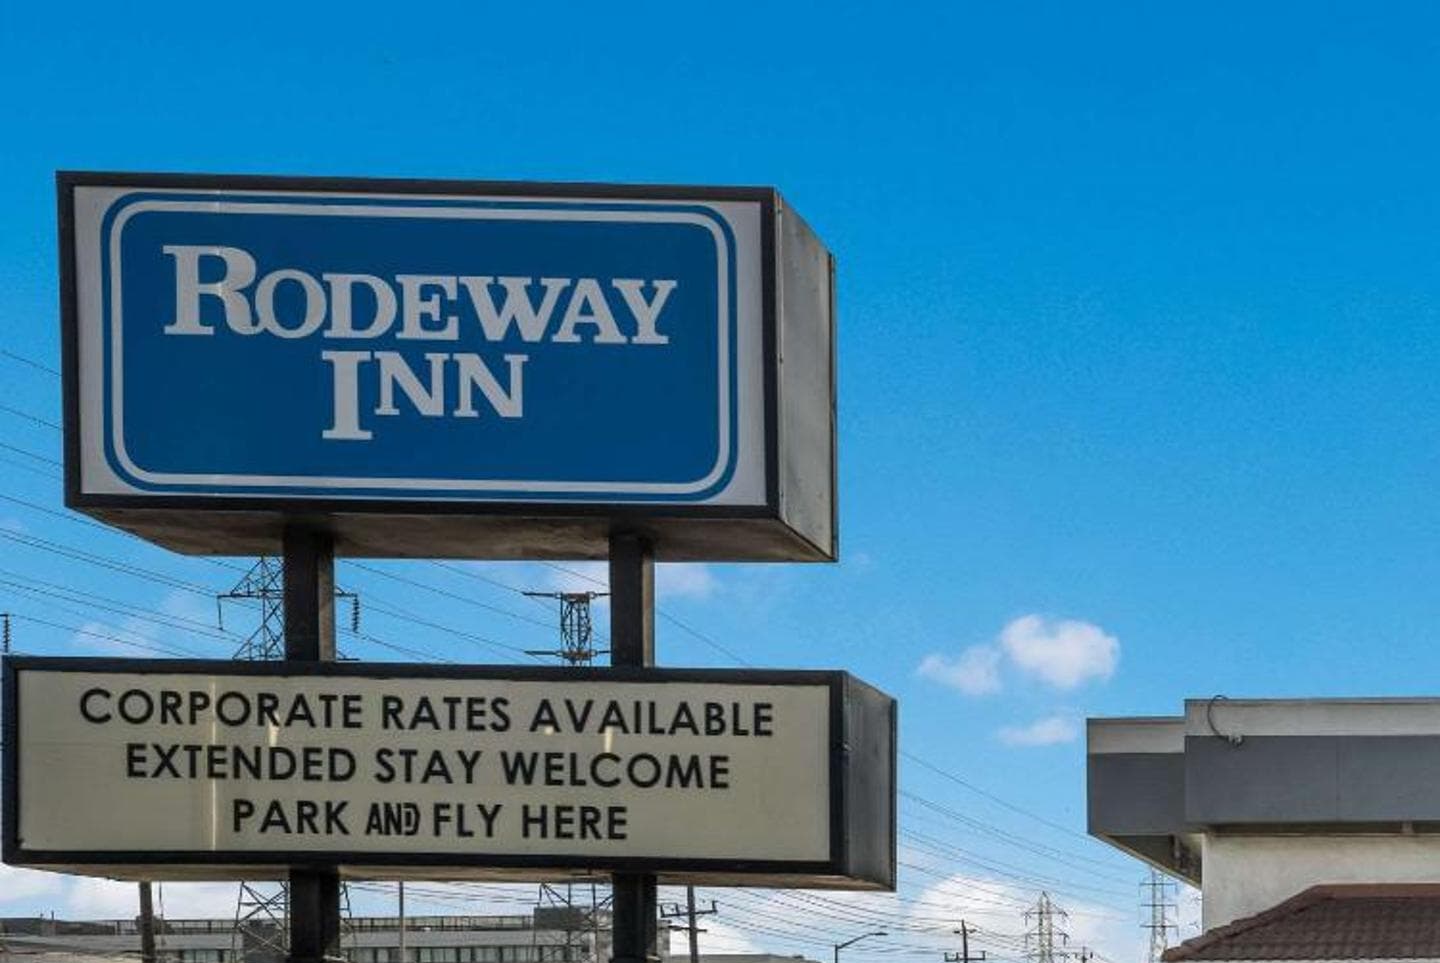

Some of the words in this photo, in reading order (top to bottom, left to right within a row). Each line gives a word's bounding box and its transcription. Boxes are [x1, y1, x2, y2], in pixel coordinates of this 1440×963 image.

[163, 245, 677, 344] RODEWAY
[321, 350, 529, 440] INN
[79, 688, 363, 729] CORPORATE
[381, 695, 511, 732] RATES
[529, 699, 774, 736] AVAILABLE
[126, 743, 356, 781] EXTENDED
[374, 748, 482, 784] STAY
[501, 751, 729, 788] WELCOME
[232, 799, 350, 834] PARK
[365, 802, 420, 836] AND
[433, 803, 503, 838] FLY
[522, 804, 628, 839] HERE
